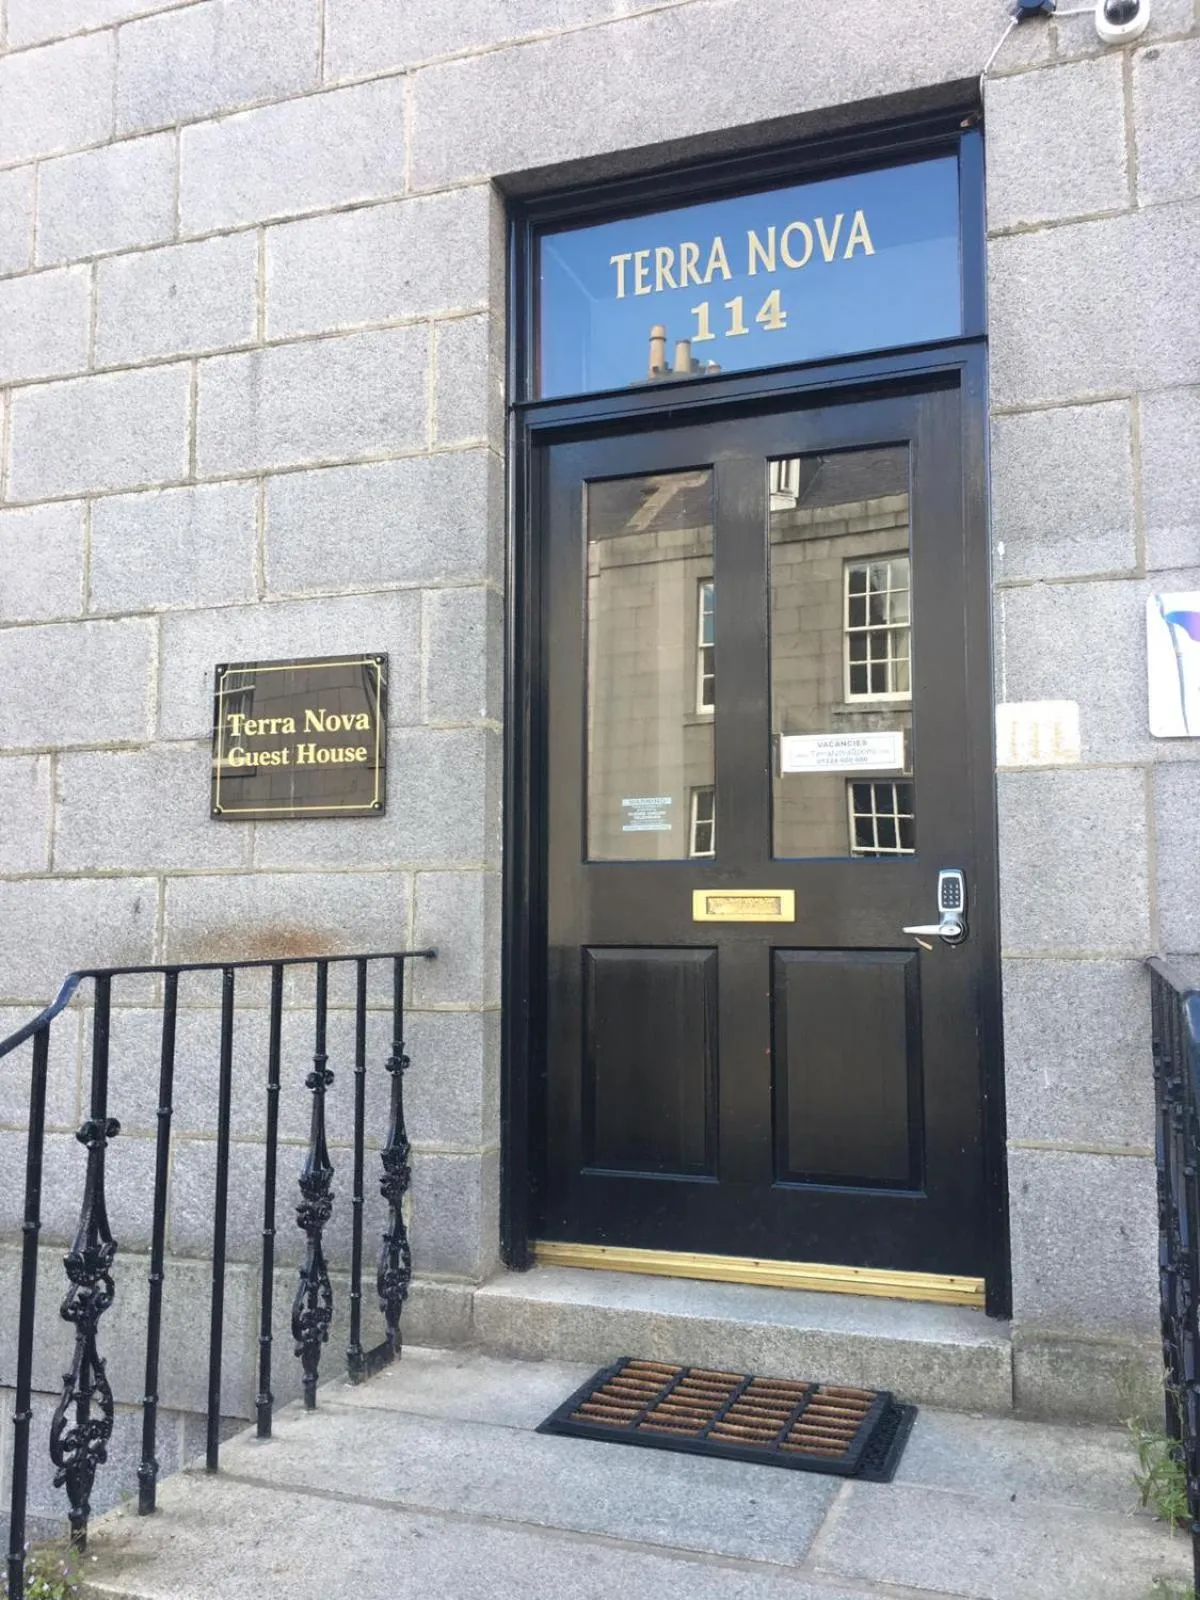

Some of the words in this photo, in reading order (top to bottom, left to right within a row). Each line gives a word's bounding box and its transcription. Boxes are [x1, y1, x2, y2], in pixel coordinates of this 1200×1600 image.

[609, 236, 732, 299] TERRA
[747, 209, 876, 276] NOVA
[691, 289, 788, 343] 114
[227, 713, 296, 737] Terra
[303, 708, 370, 733] Nova
[227, 746, 290, 767] Guest
[296, 743, 367, 764] House
